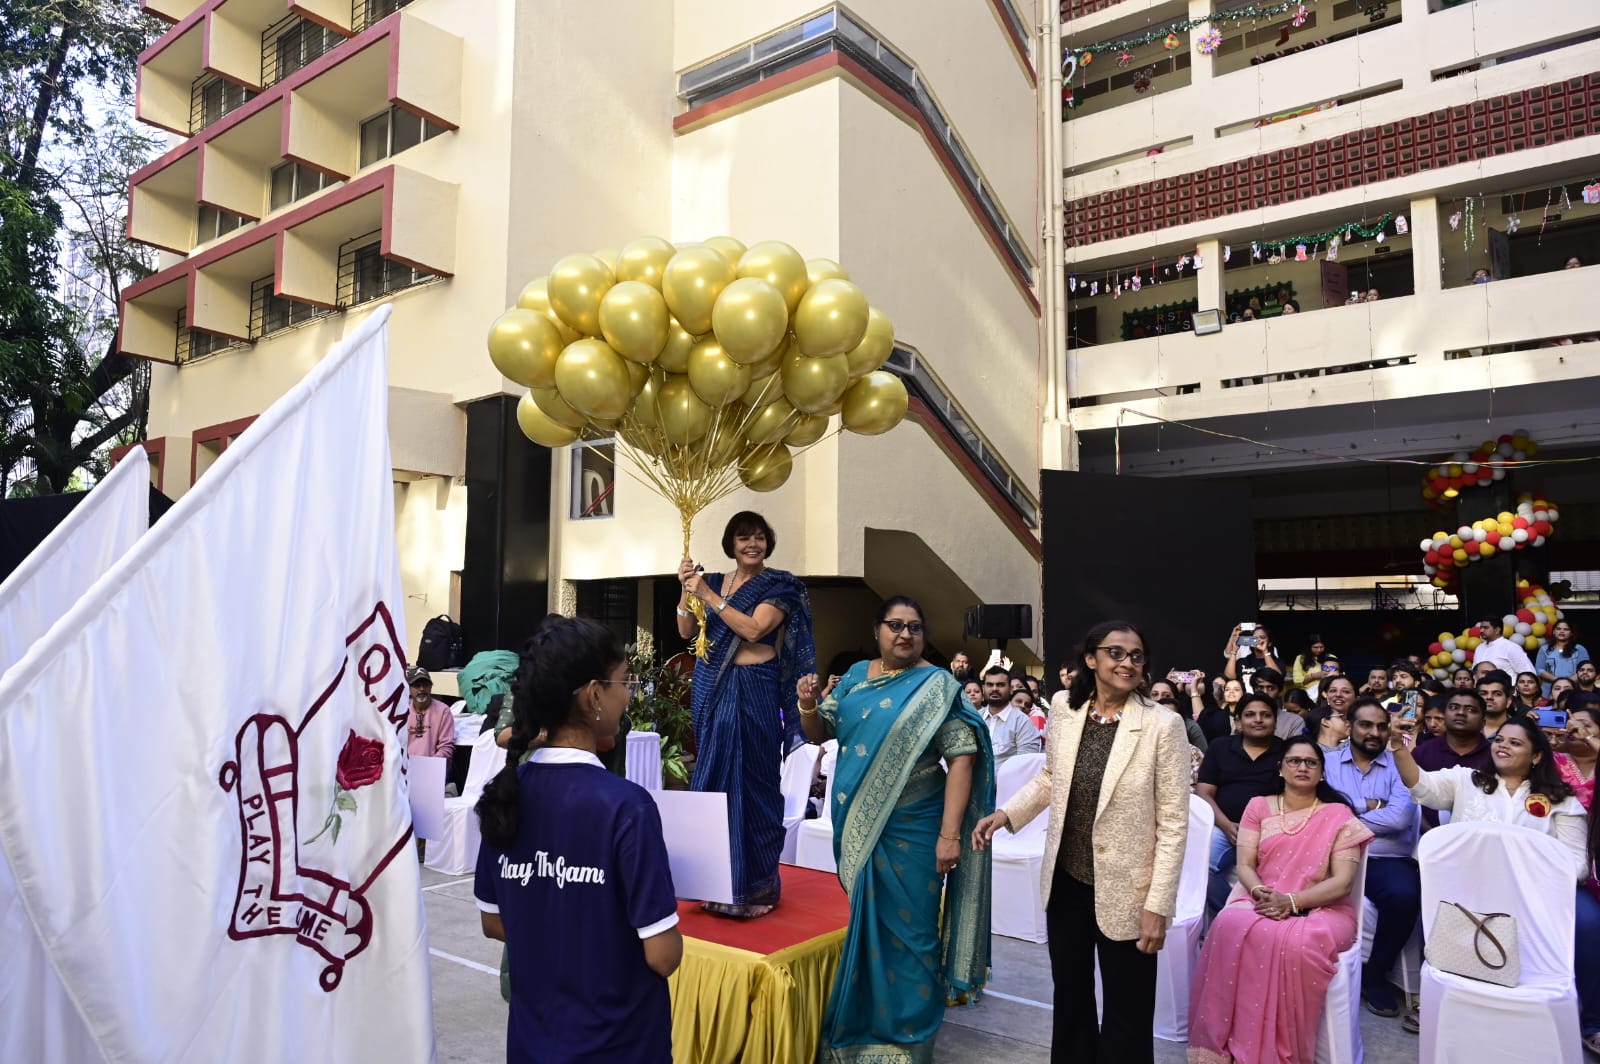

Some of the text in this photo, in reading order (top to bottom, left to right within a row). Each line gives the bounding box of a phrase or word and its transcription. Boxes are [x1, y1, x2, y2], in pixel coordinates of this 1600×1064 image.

[241, 793, 332, 941] PLAY THE ME
[535, 850, 555, 878] Th
[556, 856, 605, 889] Game
